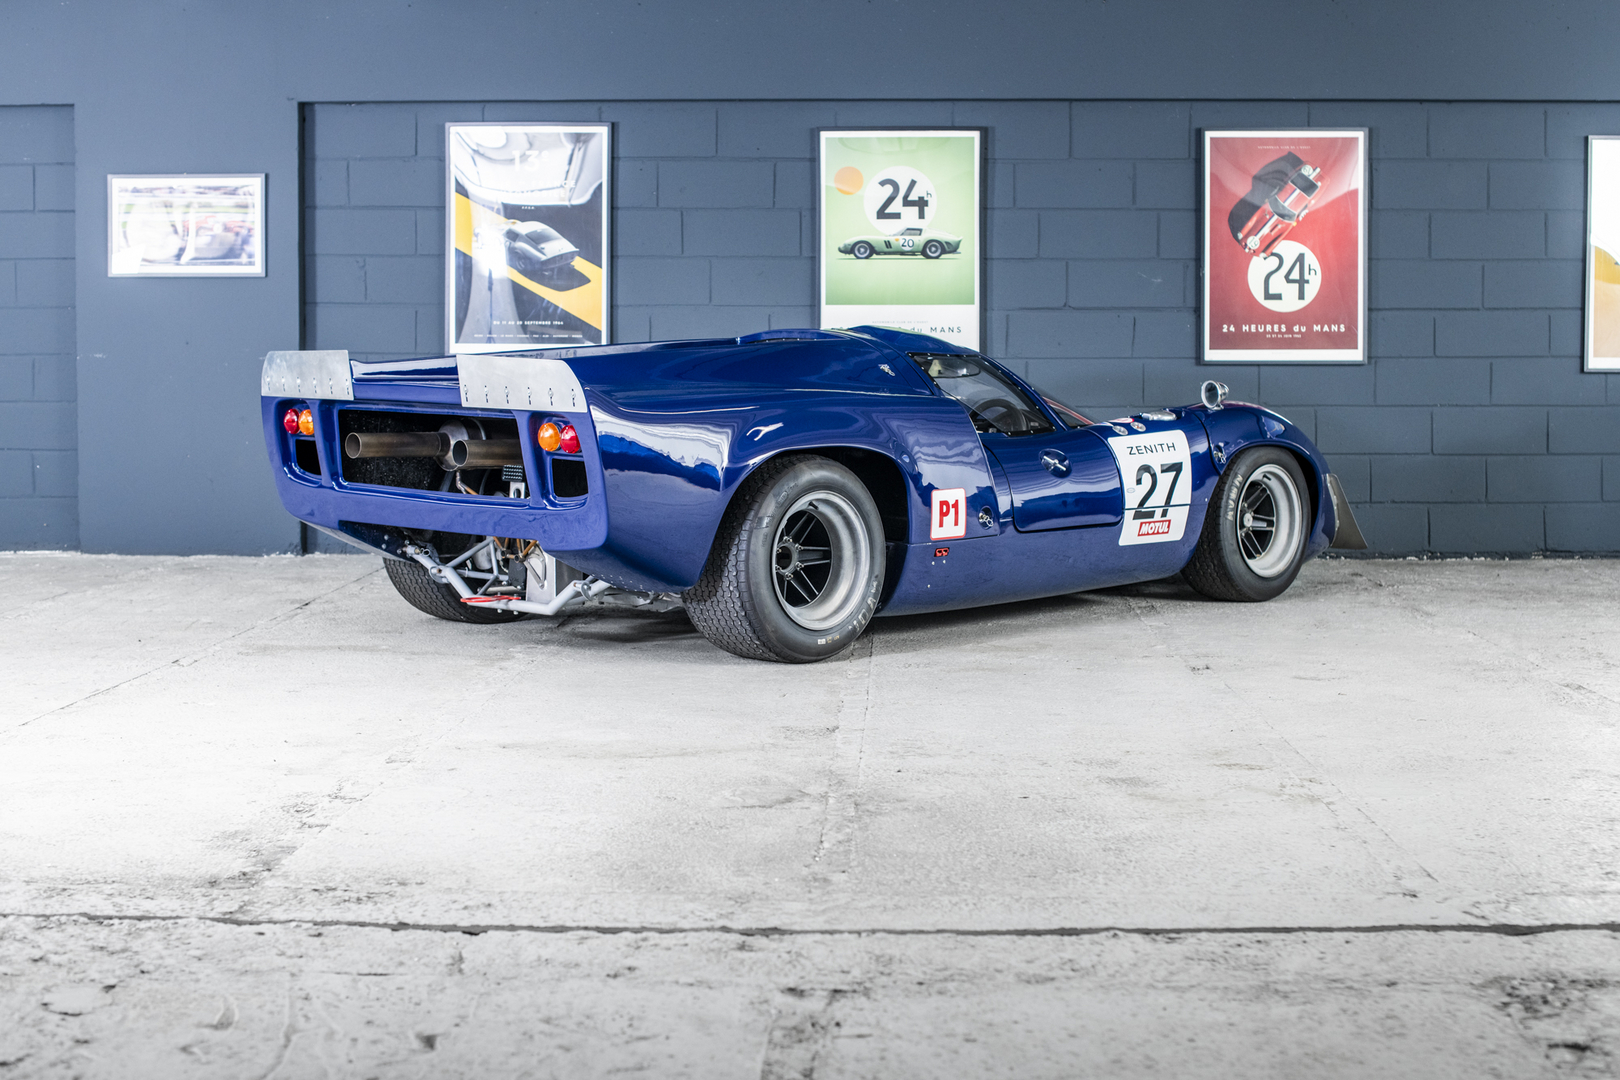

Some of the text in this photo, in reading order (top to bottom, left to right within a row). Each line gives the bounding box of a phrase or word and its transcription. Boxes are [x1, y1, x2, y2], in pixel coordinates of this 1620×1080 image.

[901, 237, 915, 249] 20
[930, 326, 962, 334] MANS
[1222, 324, 1346, 333] 24 HEURES du MANS
[1126, 442, 1177, 456] ZENITH
[1132, 461, 1184, 520] 27
[938, 499, 959, 528] P1
[1139, 521, 1170, 535] MOTUL
